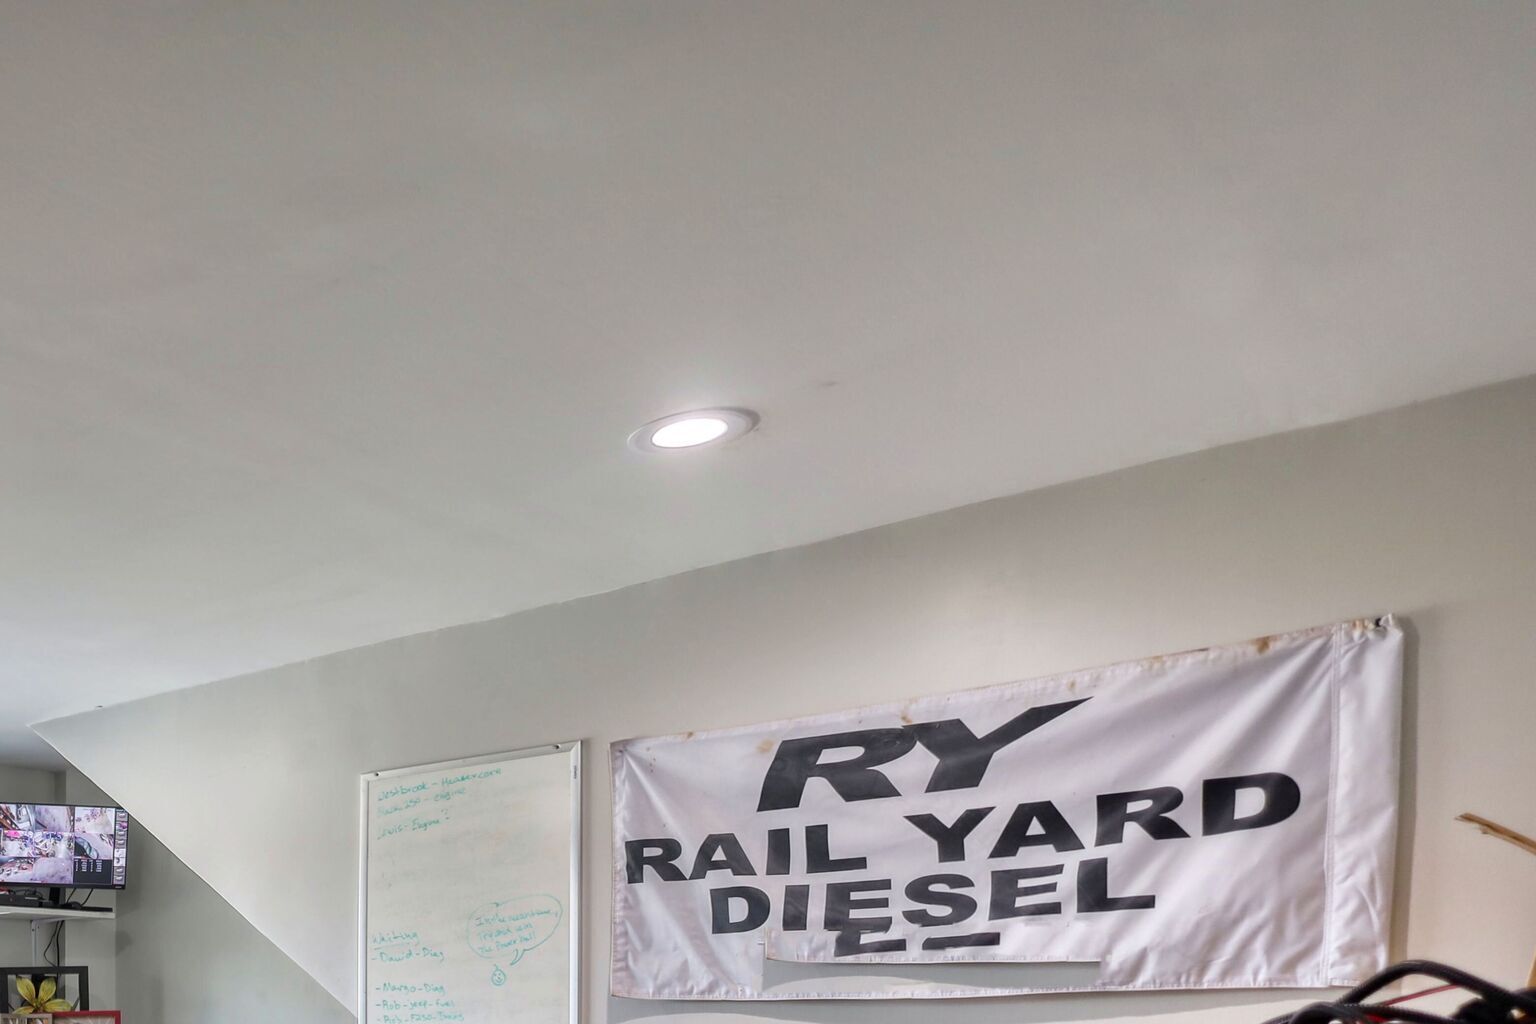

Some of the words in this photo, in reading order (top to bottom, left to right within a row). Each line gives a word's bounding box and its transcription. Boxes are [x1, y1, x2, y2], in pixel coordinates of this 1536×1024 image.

[756, 696, 1094, 812] RY
[624, 823, 867, 884] RAIL
[904, 772, 1301, 864] YARD
[710, 857, 1156, 936] DIESEL
